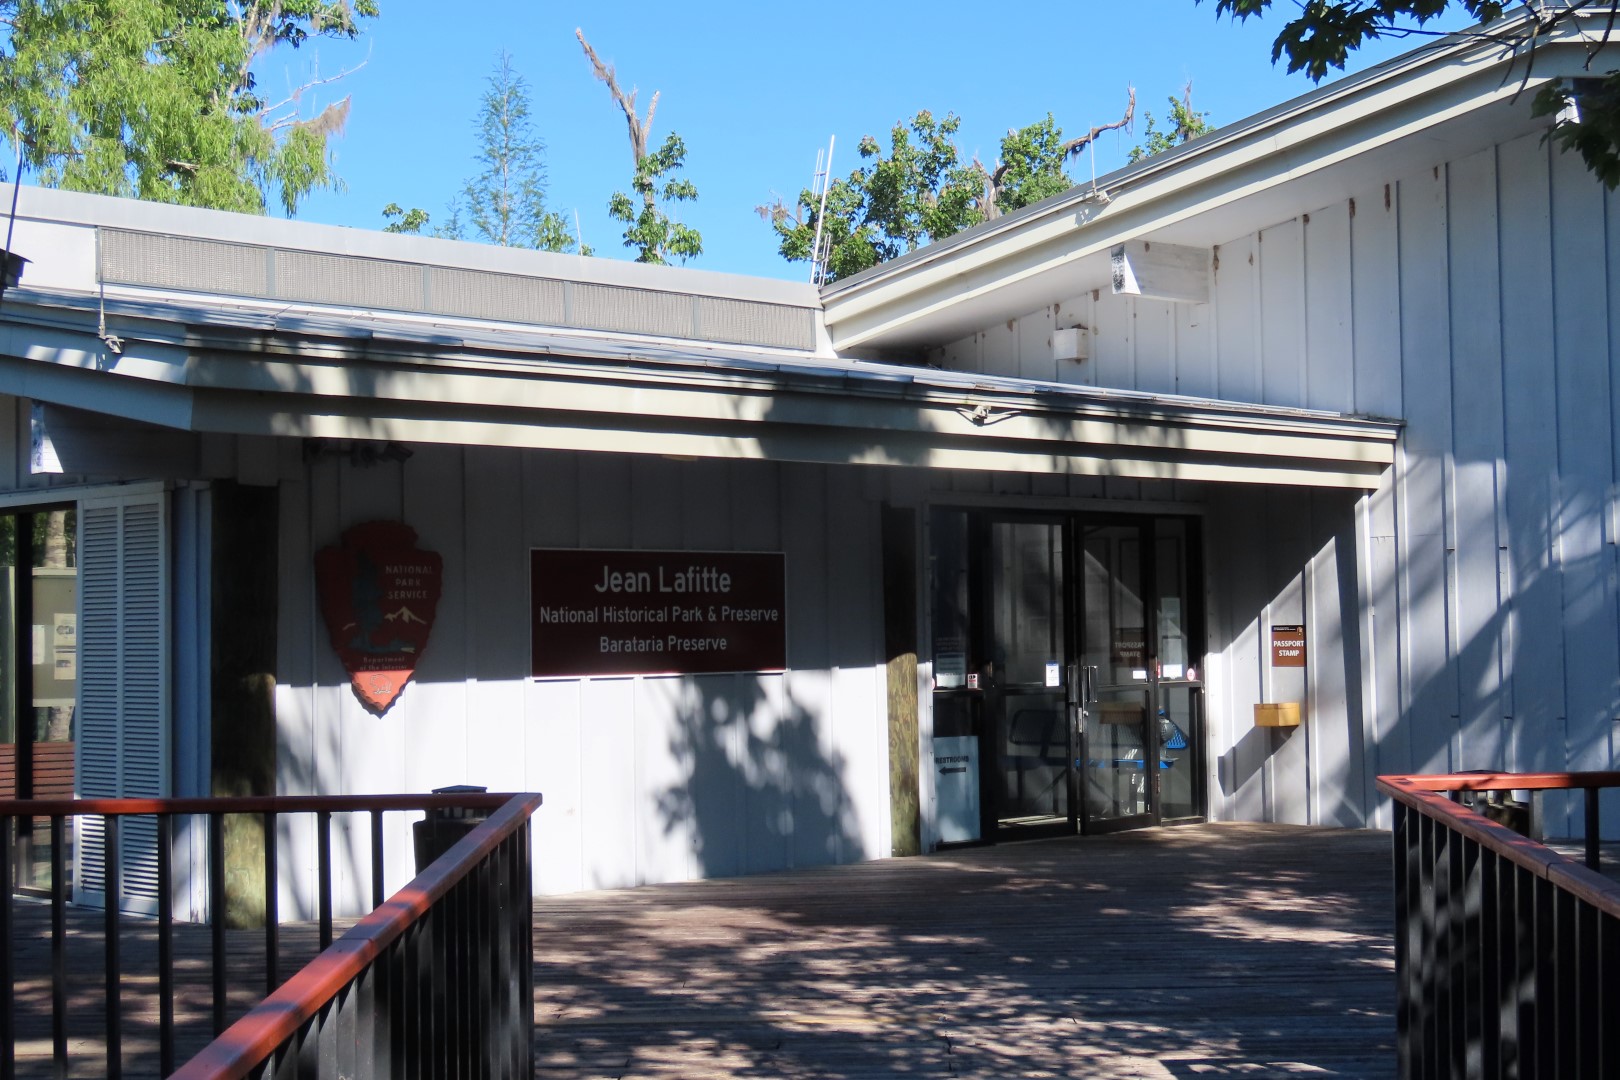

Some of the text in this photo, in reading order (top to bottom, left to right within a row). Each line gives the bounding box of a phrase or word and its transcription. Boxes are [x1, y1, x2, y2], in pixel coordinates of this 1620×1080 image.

[385, 565, 433, 574] NATIONAL
[395, 578, 421, 587] PARK
[594, 565, 731, 593] Jean Lafitte
[387, 590, 428, 600] SERVICE
[540, 606, 778, 623] National Historical Park & Preserve
[600, 636, 727, 652] Barataria Preserve
[935, 755, 970, 764] RESTROOMS
